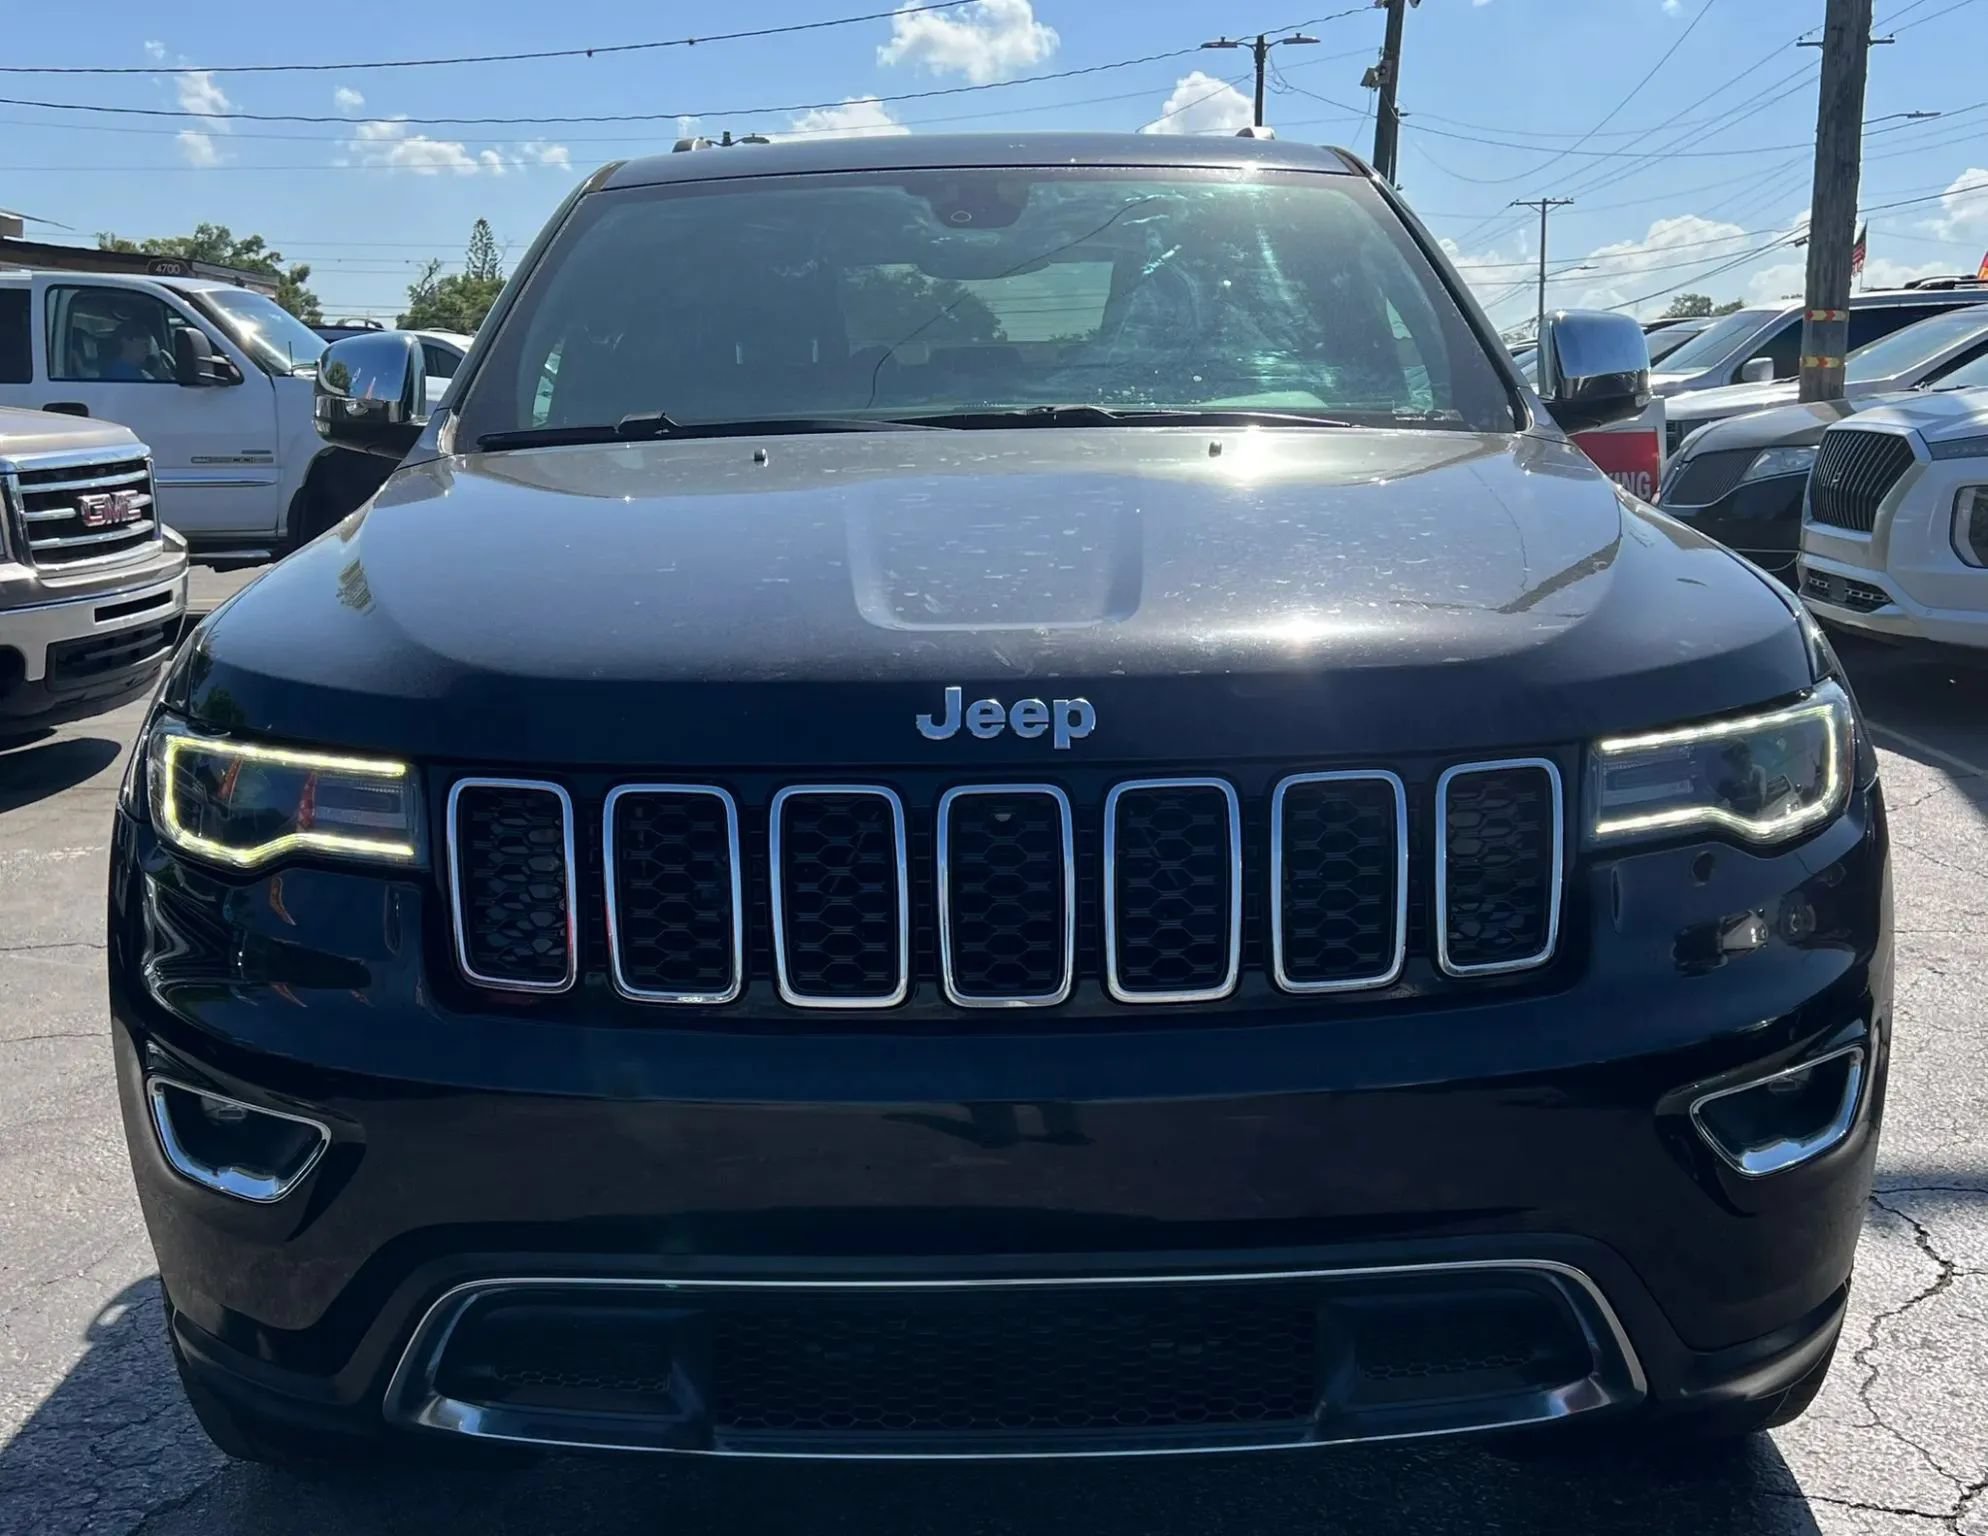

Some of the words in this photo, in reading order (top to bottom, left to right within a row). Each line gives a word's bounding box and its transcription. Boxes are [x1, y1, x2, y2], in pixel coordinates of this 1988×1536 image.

[155, 263, 180, 274] 4700
[77, 490, 141, 527] GMC
[916, 686, 1096, 749] Jeep
